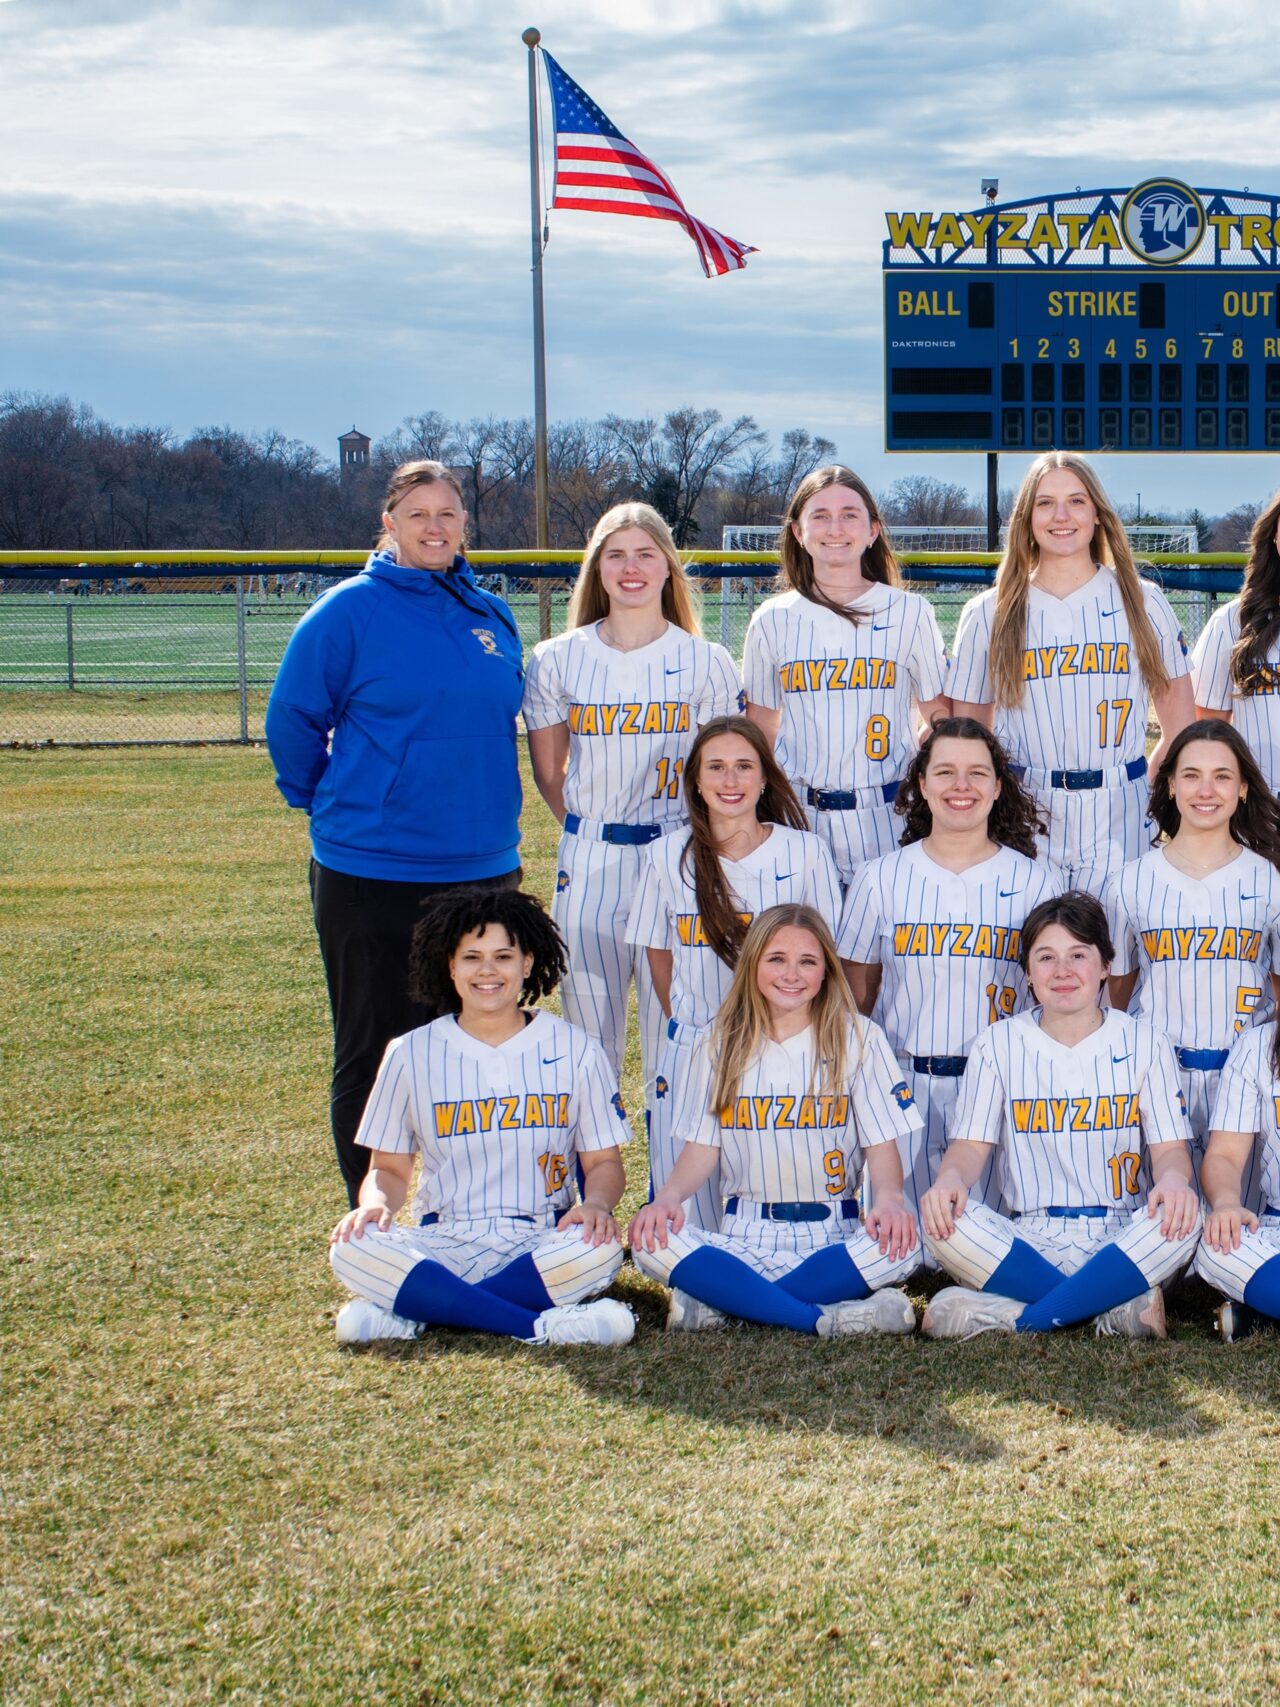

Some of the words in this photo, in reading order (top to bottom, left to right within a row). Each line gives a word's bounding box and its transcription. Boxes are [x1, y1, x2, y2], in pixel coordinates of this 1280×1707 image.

[885, 212, 1122, 250] WAYZATA
[898, 291, 961, 316] BALL
[1048, 291, 1137, 317] STRIKE
[1223, 291, 1274, 317] OUT
[892, 340, 956, 348] DAKTRONICS
[1009, 338, 1019, 359] 1
[1038, 338, 1050, 359] 2
[1068, 338, 1080, 359] 3
[1104, 338, 1117, 359] 4
[1135, 338, 1147, 359] 5
[1165, 338, 1177, 359] 6
[1201, 338, 1214, 359] 7
[1232, 338, 1244, 359] 8
[1022, 642, 1129, 681] AYZATA
[568, 702, 690, 736] WAYZATA
[865, 713, 891, 761] 8
[1097, 698, 1133, 749] 17
[651, 757, 684, 800] 11
[893, 923, 1021, 963] WAYZATA
[1140, 926, 1263, 964] WAYZATA
[433, 1093, 570, 1138] WAYZATA
[1011, 1093, 1141, 1134] WAYZATA
[537, 1151, 569, 1198] 16
[822, 1148, 847, 1196] 9
[1107, 1151, 1141, 1200] 10
